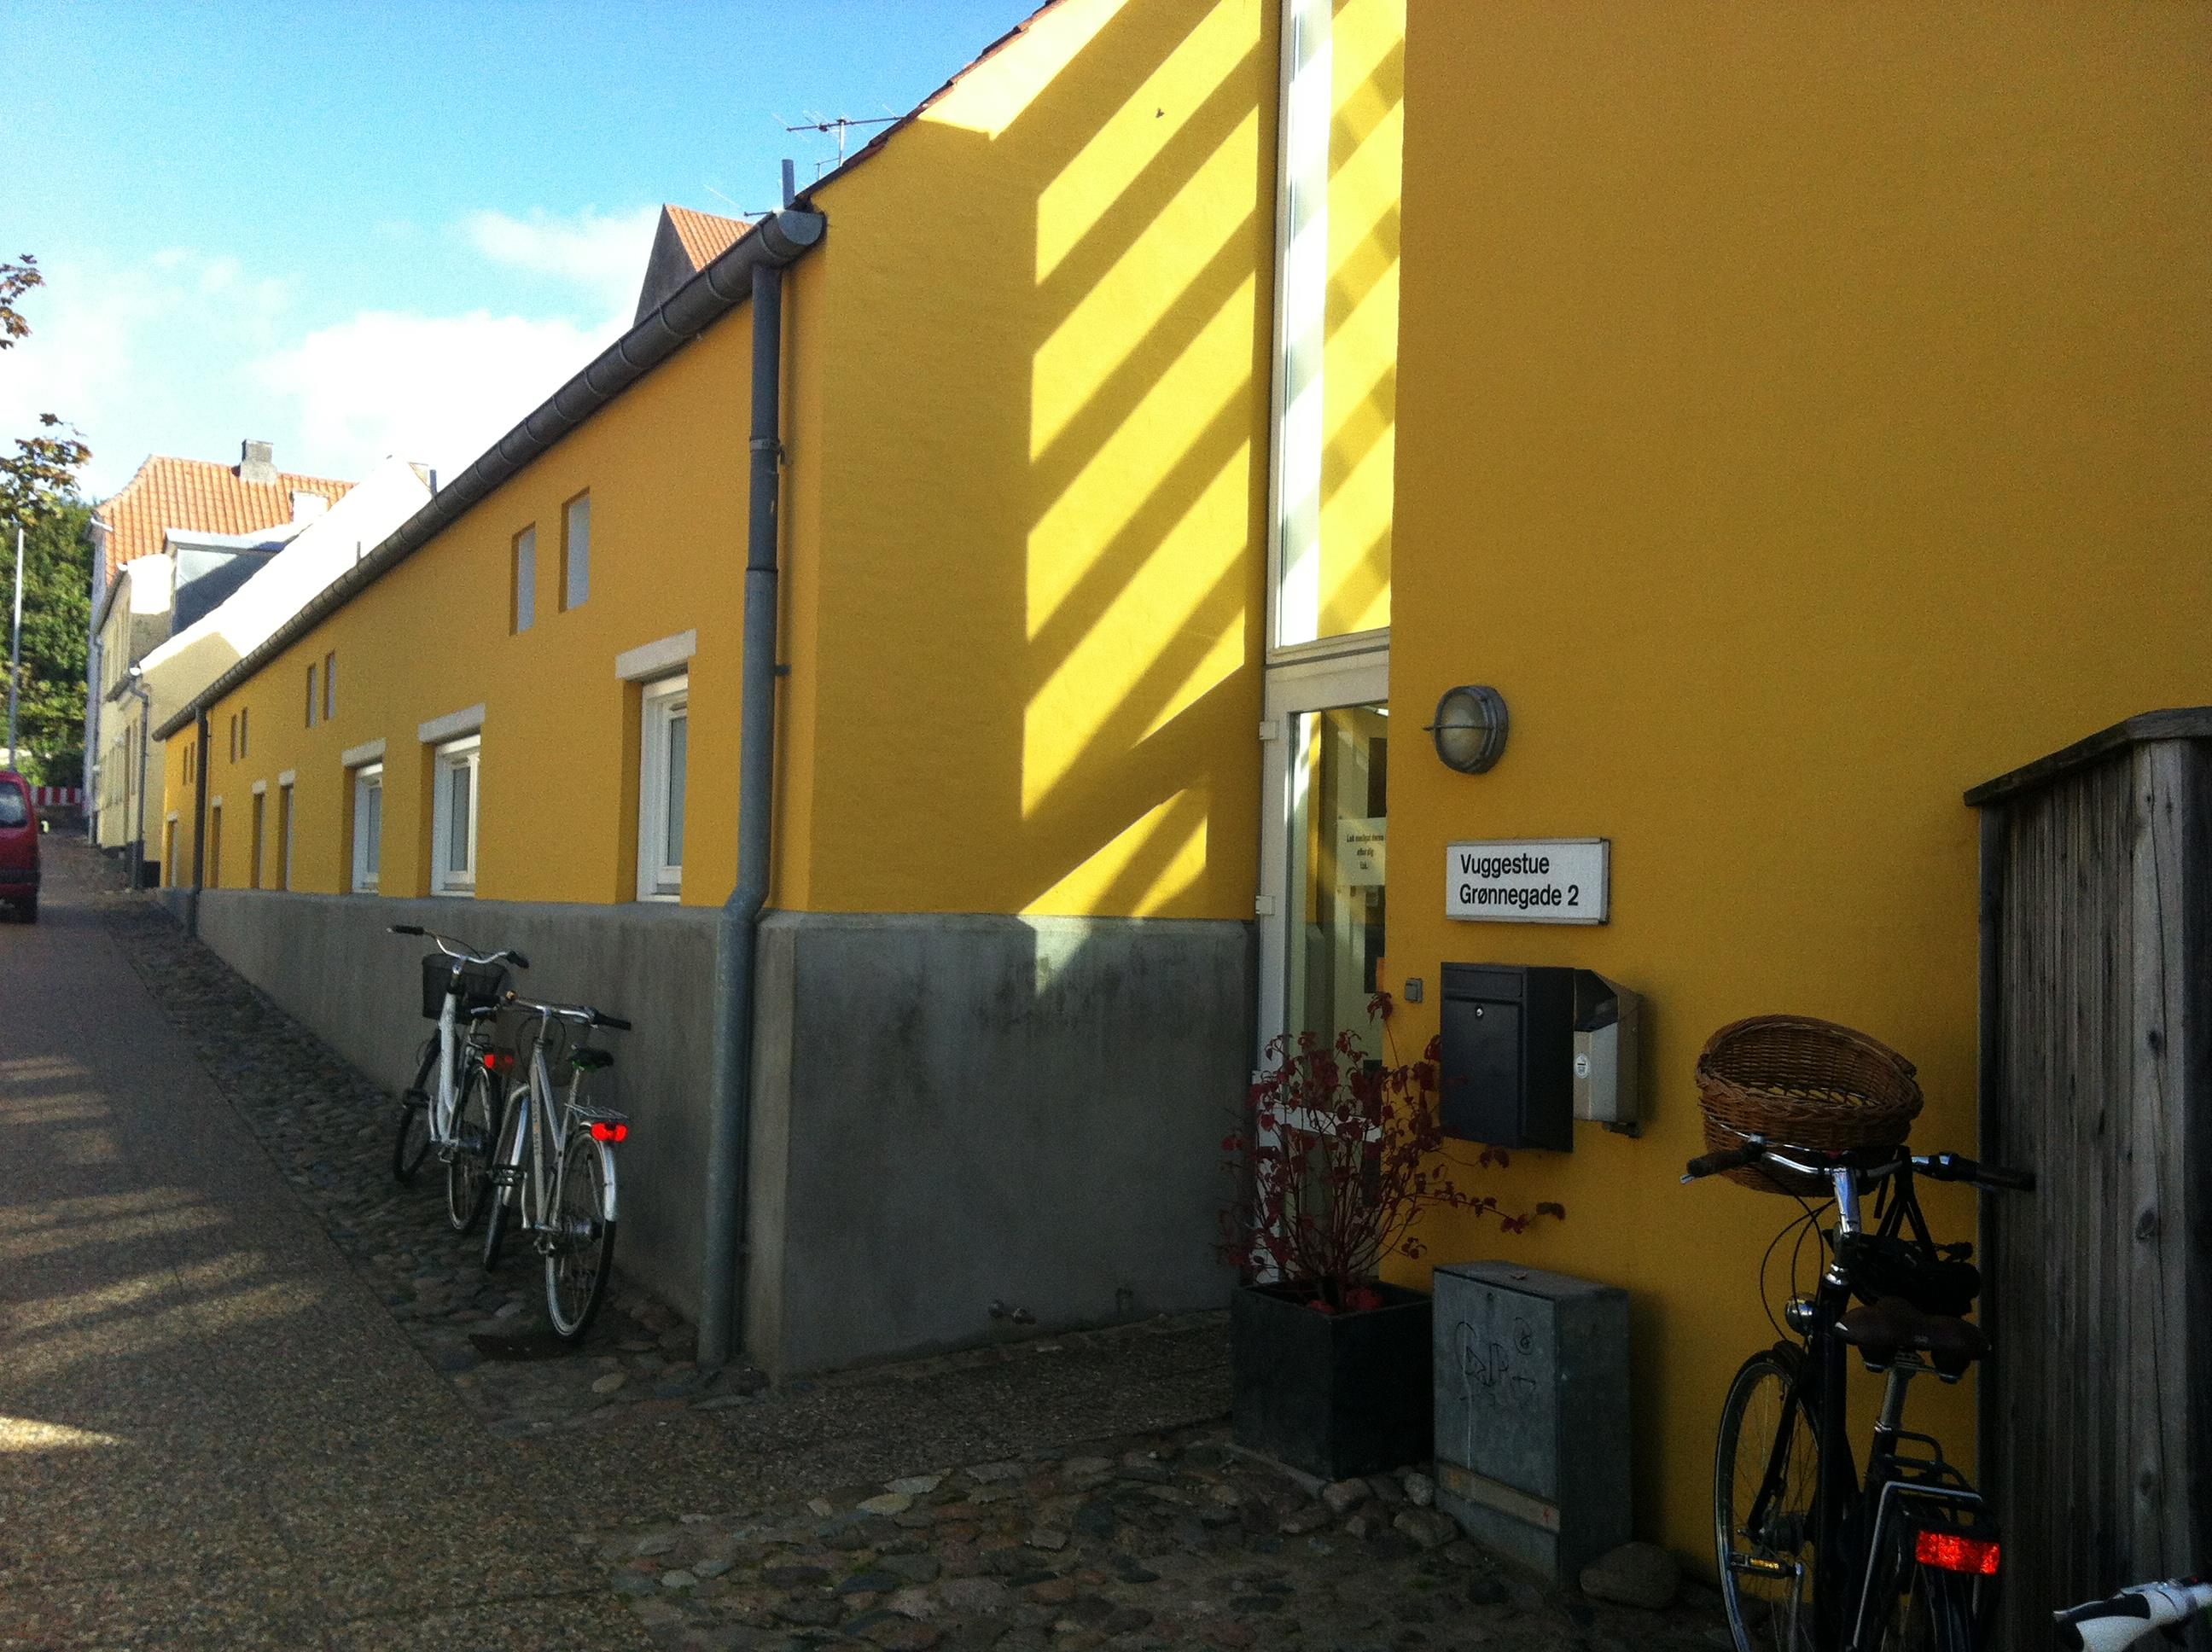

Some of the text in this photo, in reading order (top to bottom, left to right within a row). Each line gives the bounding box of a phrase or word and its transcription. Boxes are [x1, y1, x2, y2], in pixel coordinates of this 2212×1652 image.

[1460, 853, 1550, 878] Vuggestue
[1459, 883, 1579, 910] Grønnegade 2
